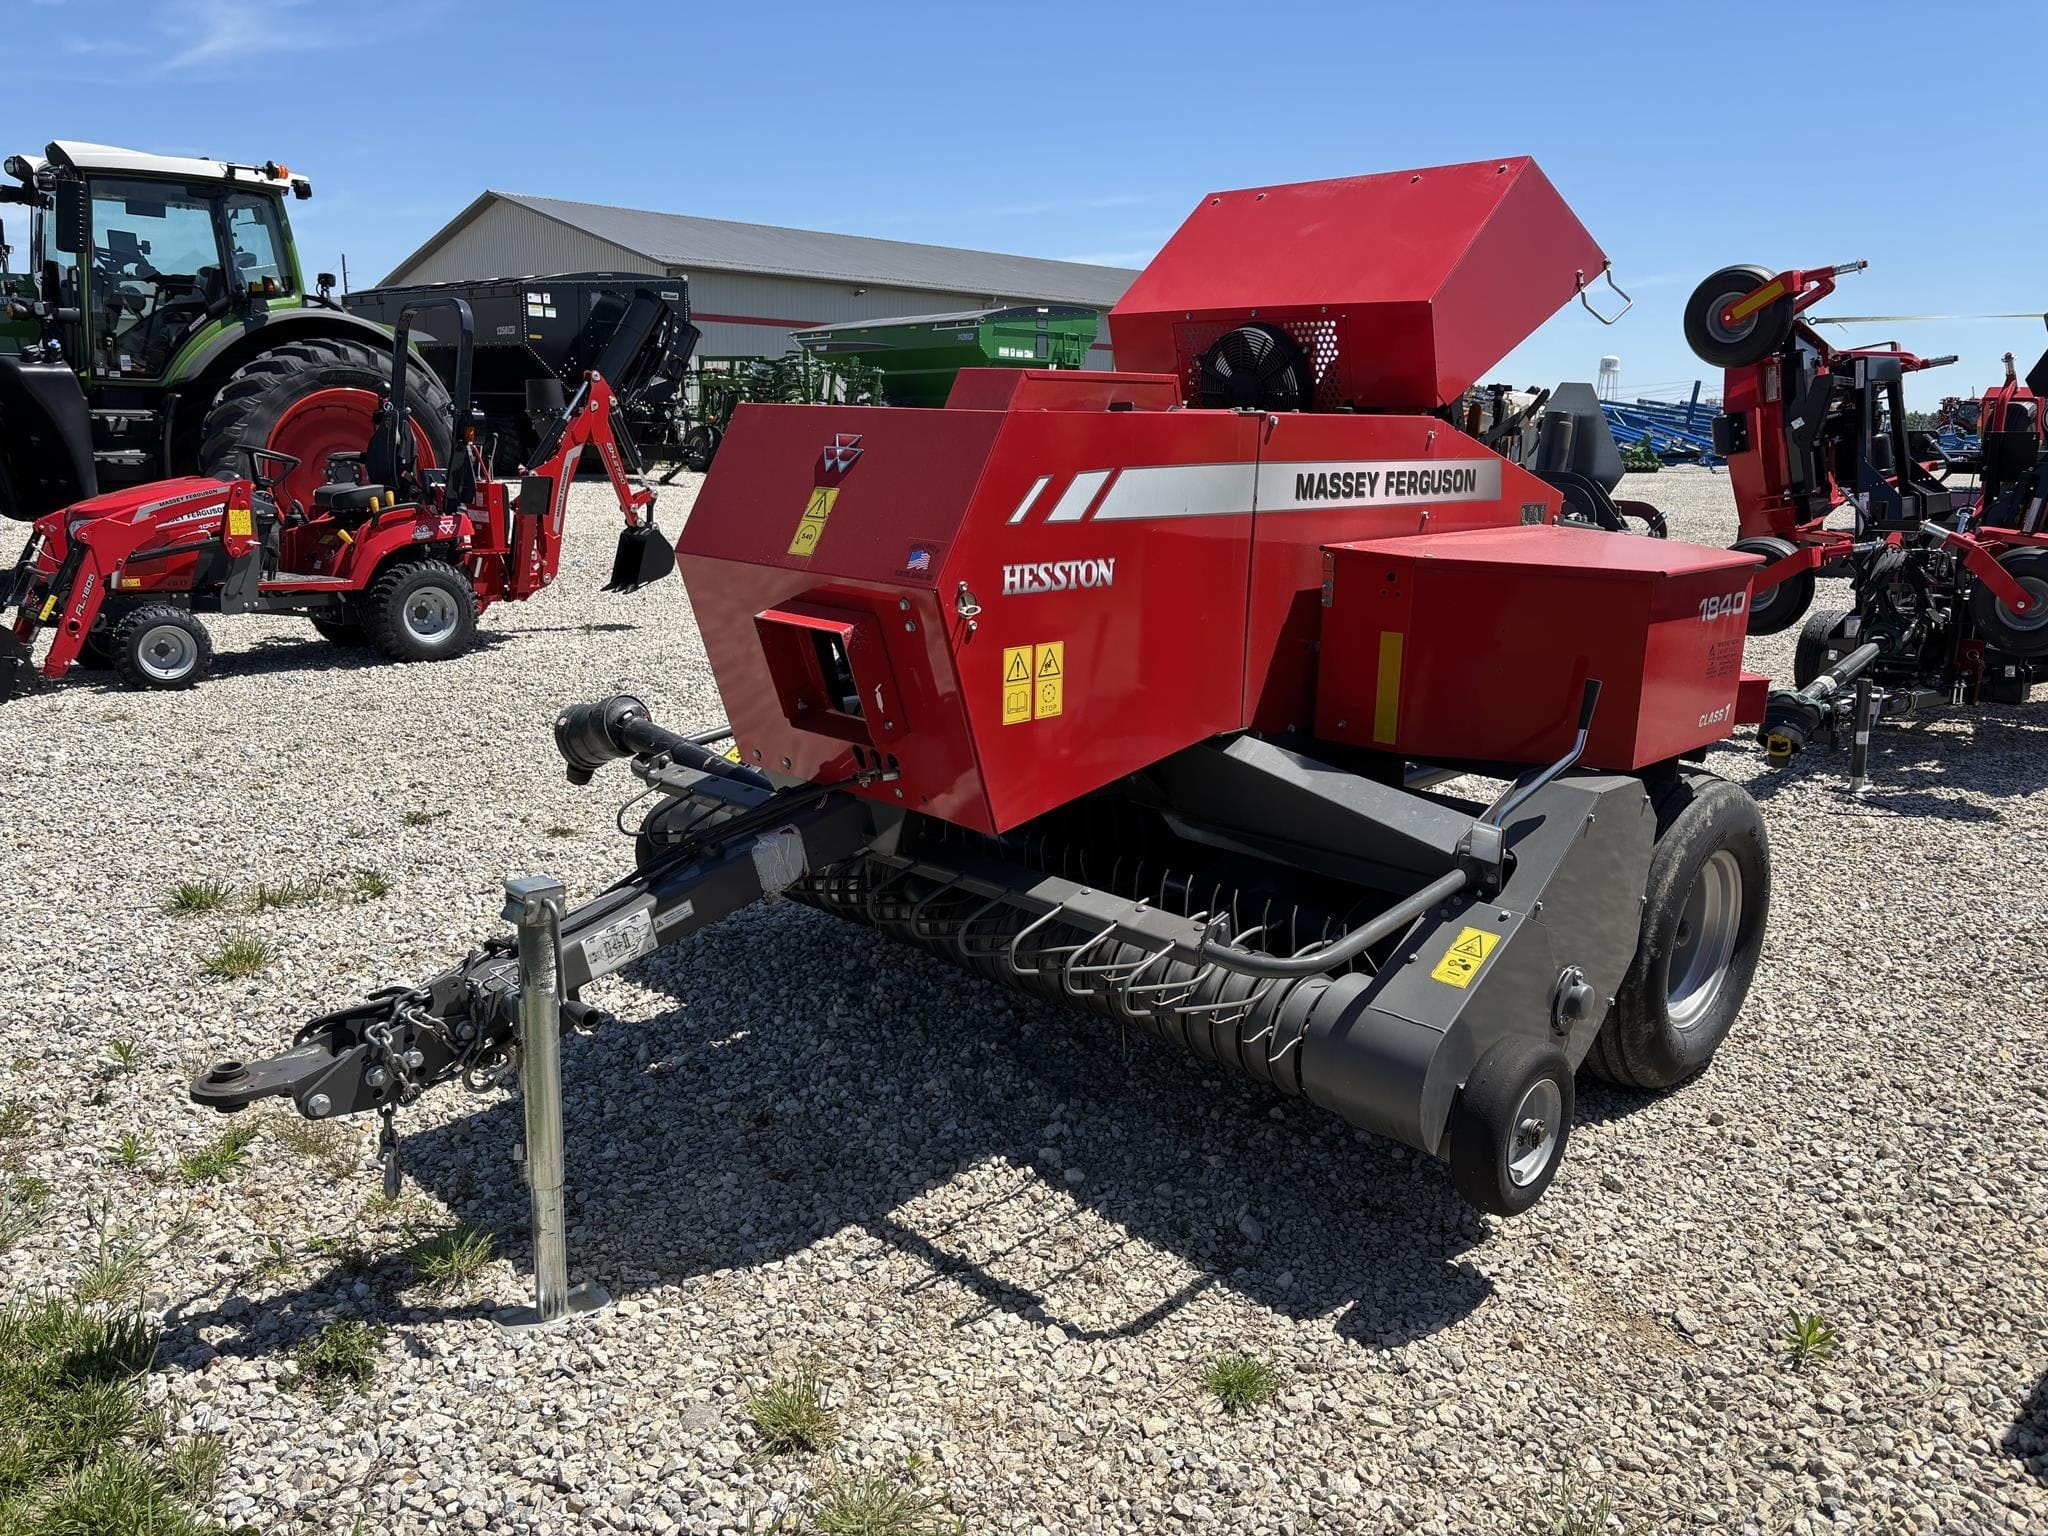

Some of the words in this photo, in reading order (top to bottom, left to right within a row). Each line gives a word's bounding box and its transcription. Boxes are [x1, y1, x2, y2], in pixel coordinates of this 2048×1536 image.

[1295, 472, 1380, 501] MASSEY
[1385, 469, 1476, 497] FERGUSON
[159, 496, 184, 507] MASSEY
[185, 489, 218, 500] FERGUSON
[801, 533, 814, 541] 540
[1002, 558, 1115, 596] HESSTON
[1698, 591, 1747, 622] 1840
[1040, 704, 1057, 713] STOP
[1698, 708, 1725, 728] CLASS
[1723, 703, 1732, 721] 1
